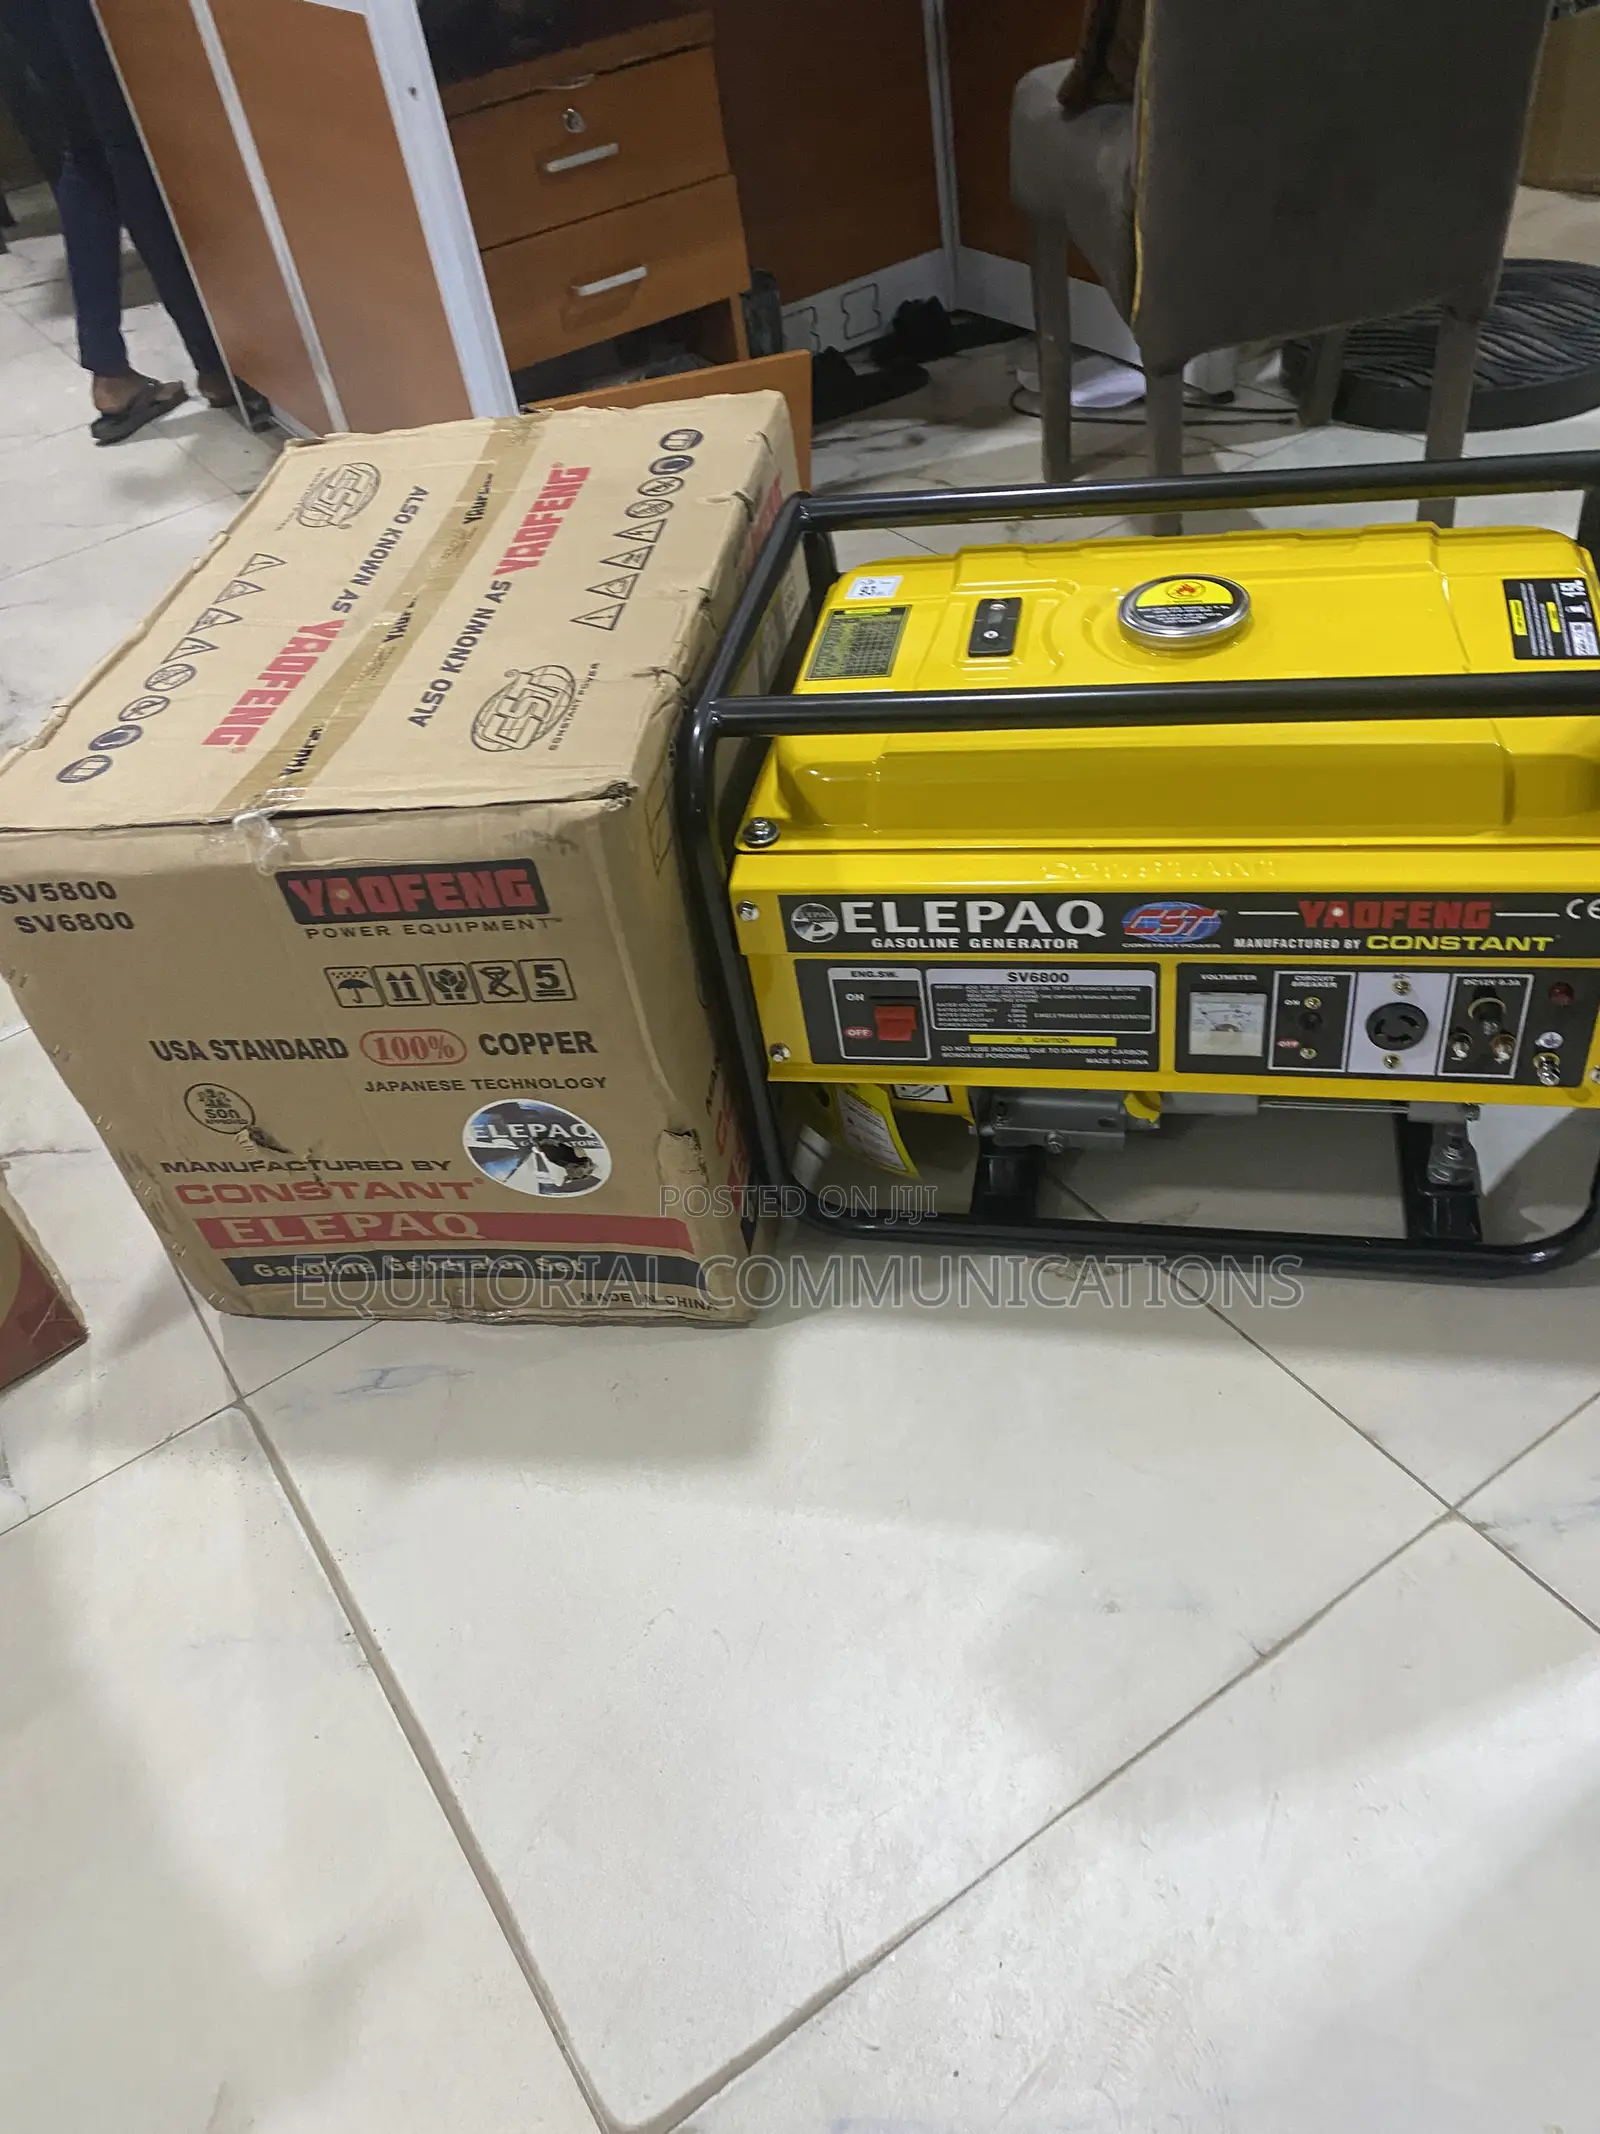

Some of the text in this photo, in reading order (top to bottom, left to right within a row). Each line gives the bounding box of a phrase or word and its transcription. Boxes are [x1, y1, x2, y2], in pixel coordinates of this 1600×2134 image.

[393, 484, 430, 525] ALSO
[492, 466, 591, 576] YAOFENG
[350, 527, 403, 587] KNOWN
[331, 588, 360, 614] AS
[407, 678, 454, 728] ALSO
[439, 607, 496, 674] KNOWN
[484, 580, 513, 604] AS
[201, 619, 346, 746] YAOFENG
[0, 881, 117, 905] SV5800
[288, 869, 537, 917] YAOFENG
[14, 912, 135, 934] SV6800
[840, 899, 1107, 938] ELEPAQ
[1298, 900, 1492, 930] YAOFENG
[304, 925, 391, 940] POWER
[871, 937, 1080, 950] GASOLINE GENERATOR
[1233, 935, 1554, 952] MANUFACTURED BY CONSTANT
[1007, 972, 1070, 983] SV6800
[845, 993, 865, 1001] ON
[847, 1029, 869, 1037] OFF
[149, 1030, 598, 1062] USA STANDARD 100% COPPER
[364, 1076, 607, 1092] JAPANESE TECHNOLOGY
[472, 1123, 595, 1139] ELEPAQ
[160, 1159, 452, 1173] MANUFACTURED BY
[175, 1181, 474, 1204] CONSTANT
[220, 1213, 489, 1244] ELEPAQ
[254, 1258, 375, 1277] Gasoline
[387, 1256, 524, 1273] Generator
